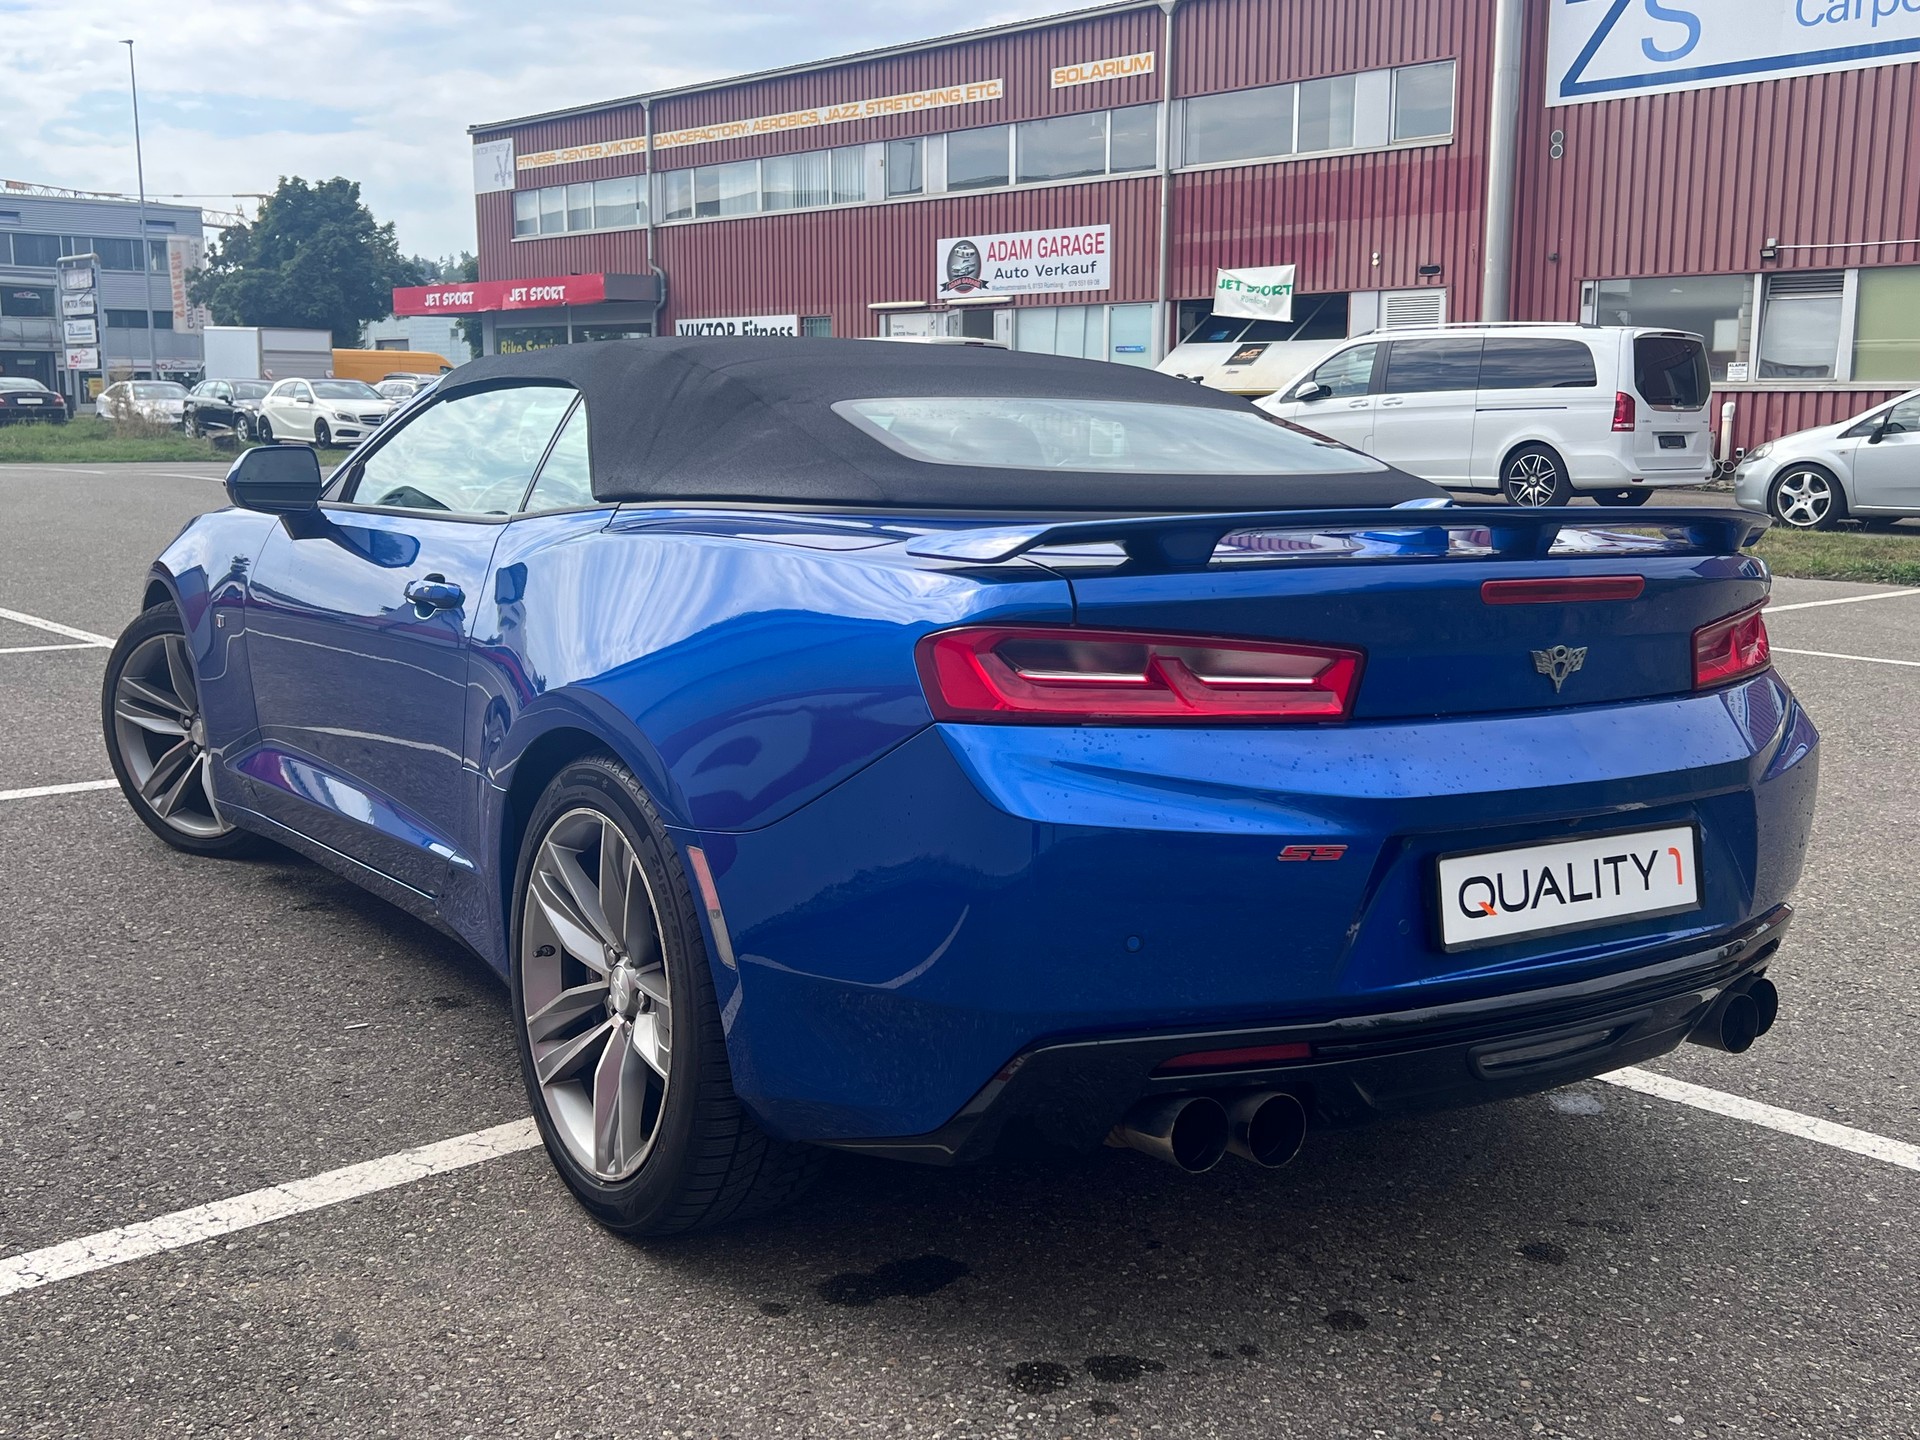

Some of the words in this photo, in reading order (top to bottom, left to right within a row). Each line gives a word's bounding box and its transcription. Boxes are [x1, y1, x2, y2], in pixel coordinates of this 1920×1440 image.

[1054, 55, 1152, 85] SOLARIUM
[653, 122, 750, 148] DANCEFACTORY:
[752, 110, 821, 133] AEROBICS,
[824, 104, 864, 121] JAZZ,
[865, 88, 964, 115] STRETCHING,
[966, 81, 1002, 102] ETC.
[986, 238, 1033, 263] ADAM
[1037, 231, 1106, 259] GARAGE
[993, 267, 1029, 280] Auto
[1034, 260, 1097, 277] Verkauf
[509, 287, 528, 302] JET
[530, 285, 566, 301] SPORT
[1218, 279, 1243, 292] JET
[425, 293, 441, 307] JET
[442, 291, 474, 306] SPORT
[1277, 844, 1349, 861] SS
